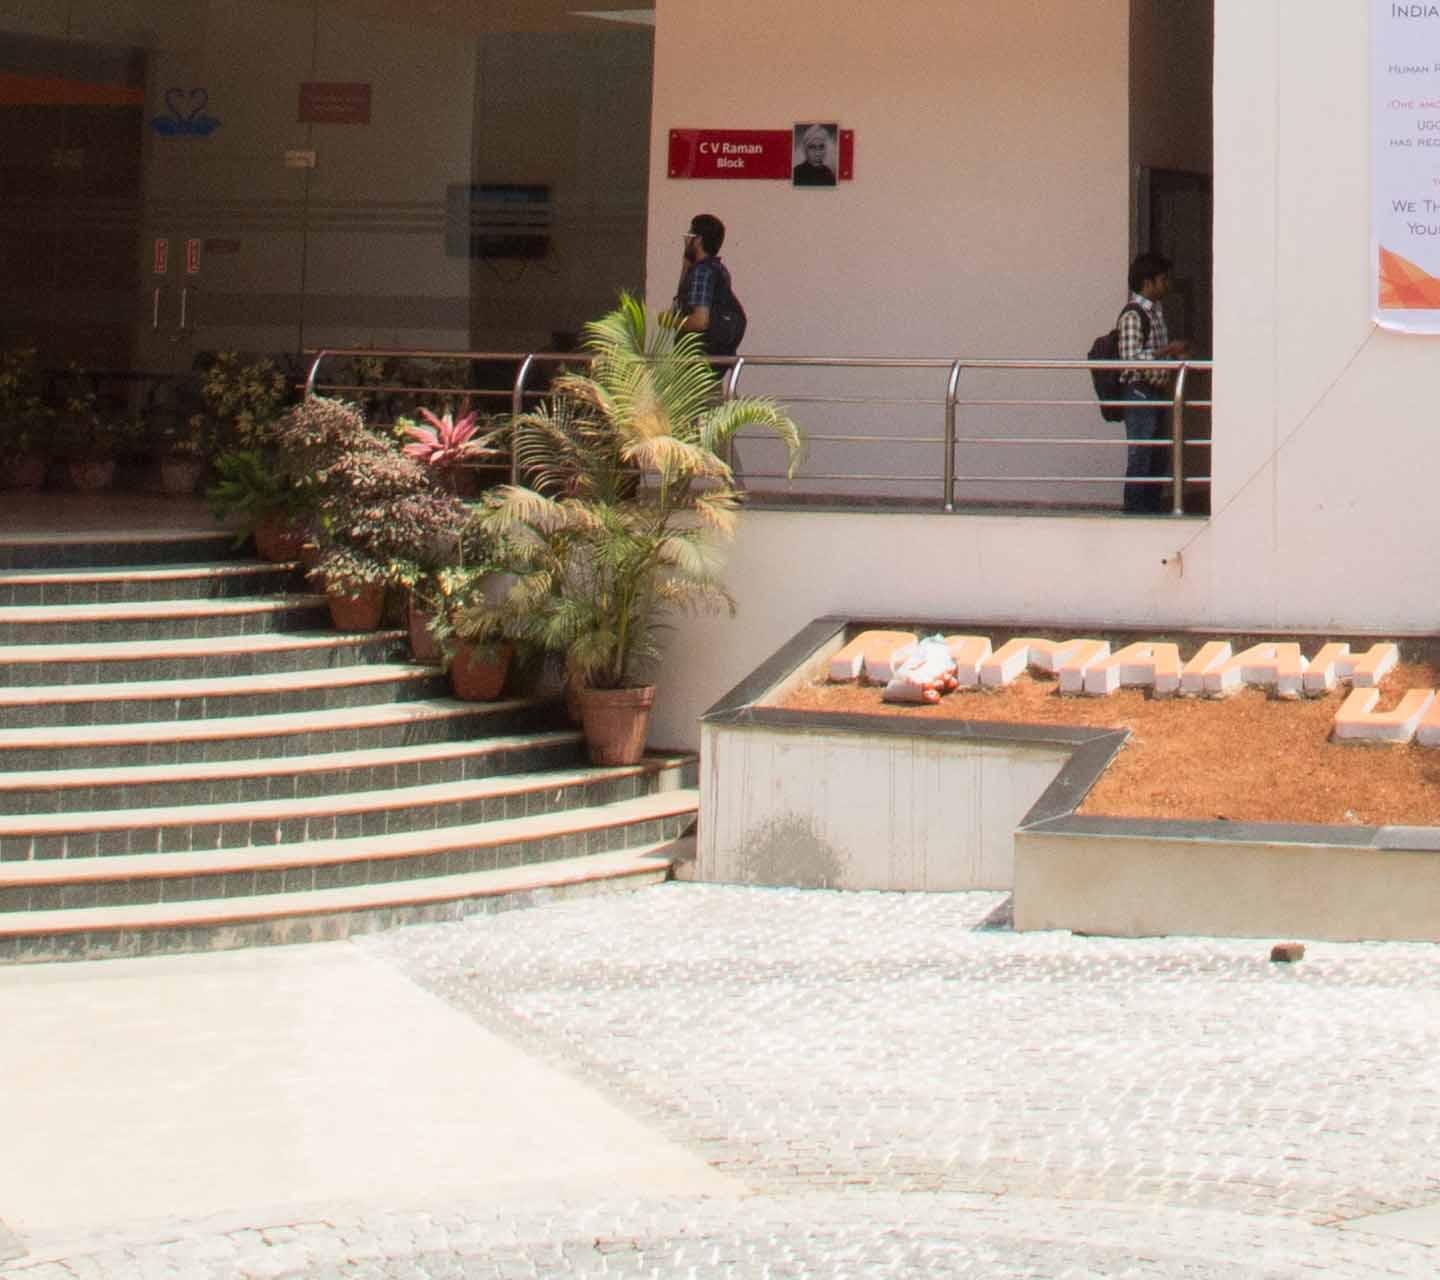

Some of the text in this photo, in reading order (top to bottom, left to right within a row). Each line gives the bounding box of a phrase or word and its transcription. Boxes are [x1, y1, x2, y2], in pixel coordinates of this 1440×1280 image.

[699, 142, 763, 155] C V Raman
[716, 157, 744, 168] Block
[1392, 200, 1416, 213] WE
